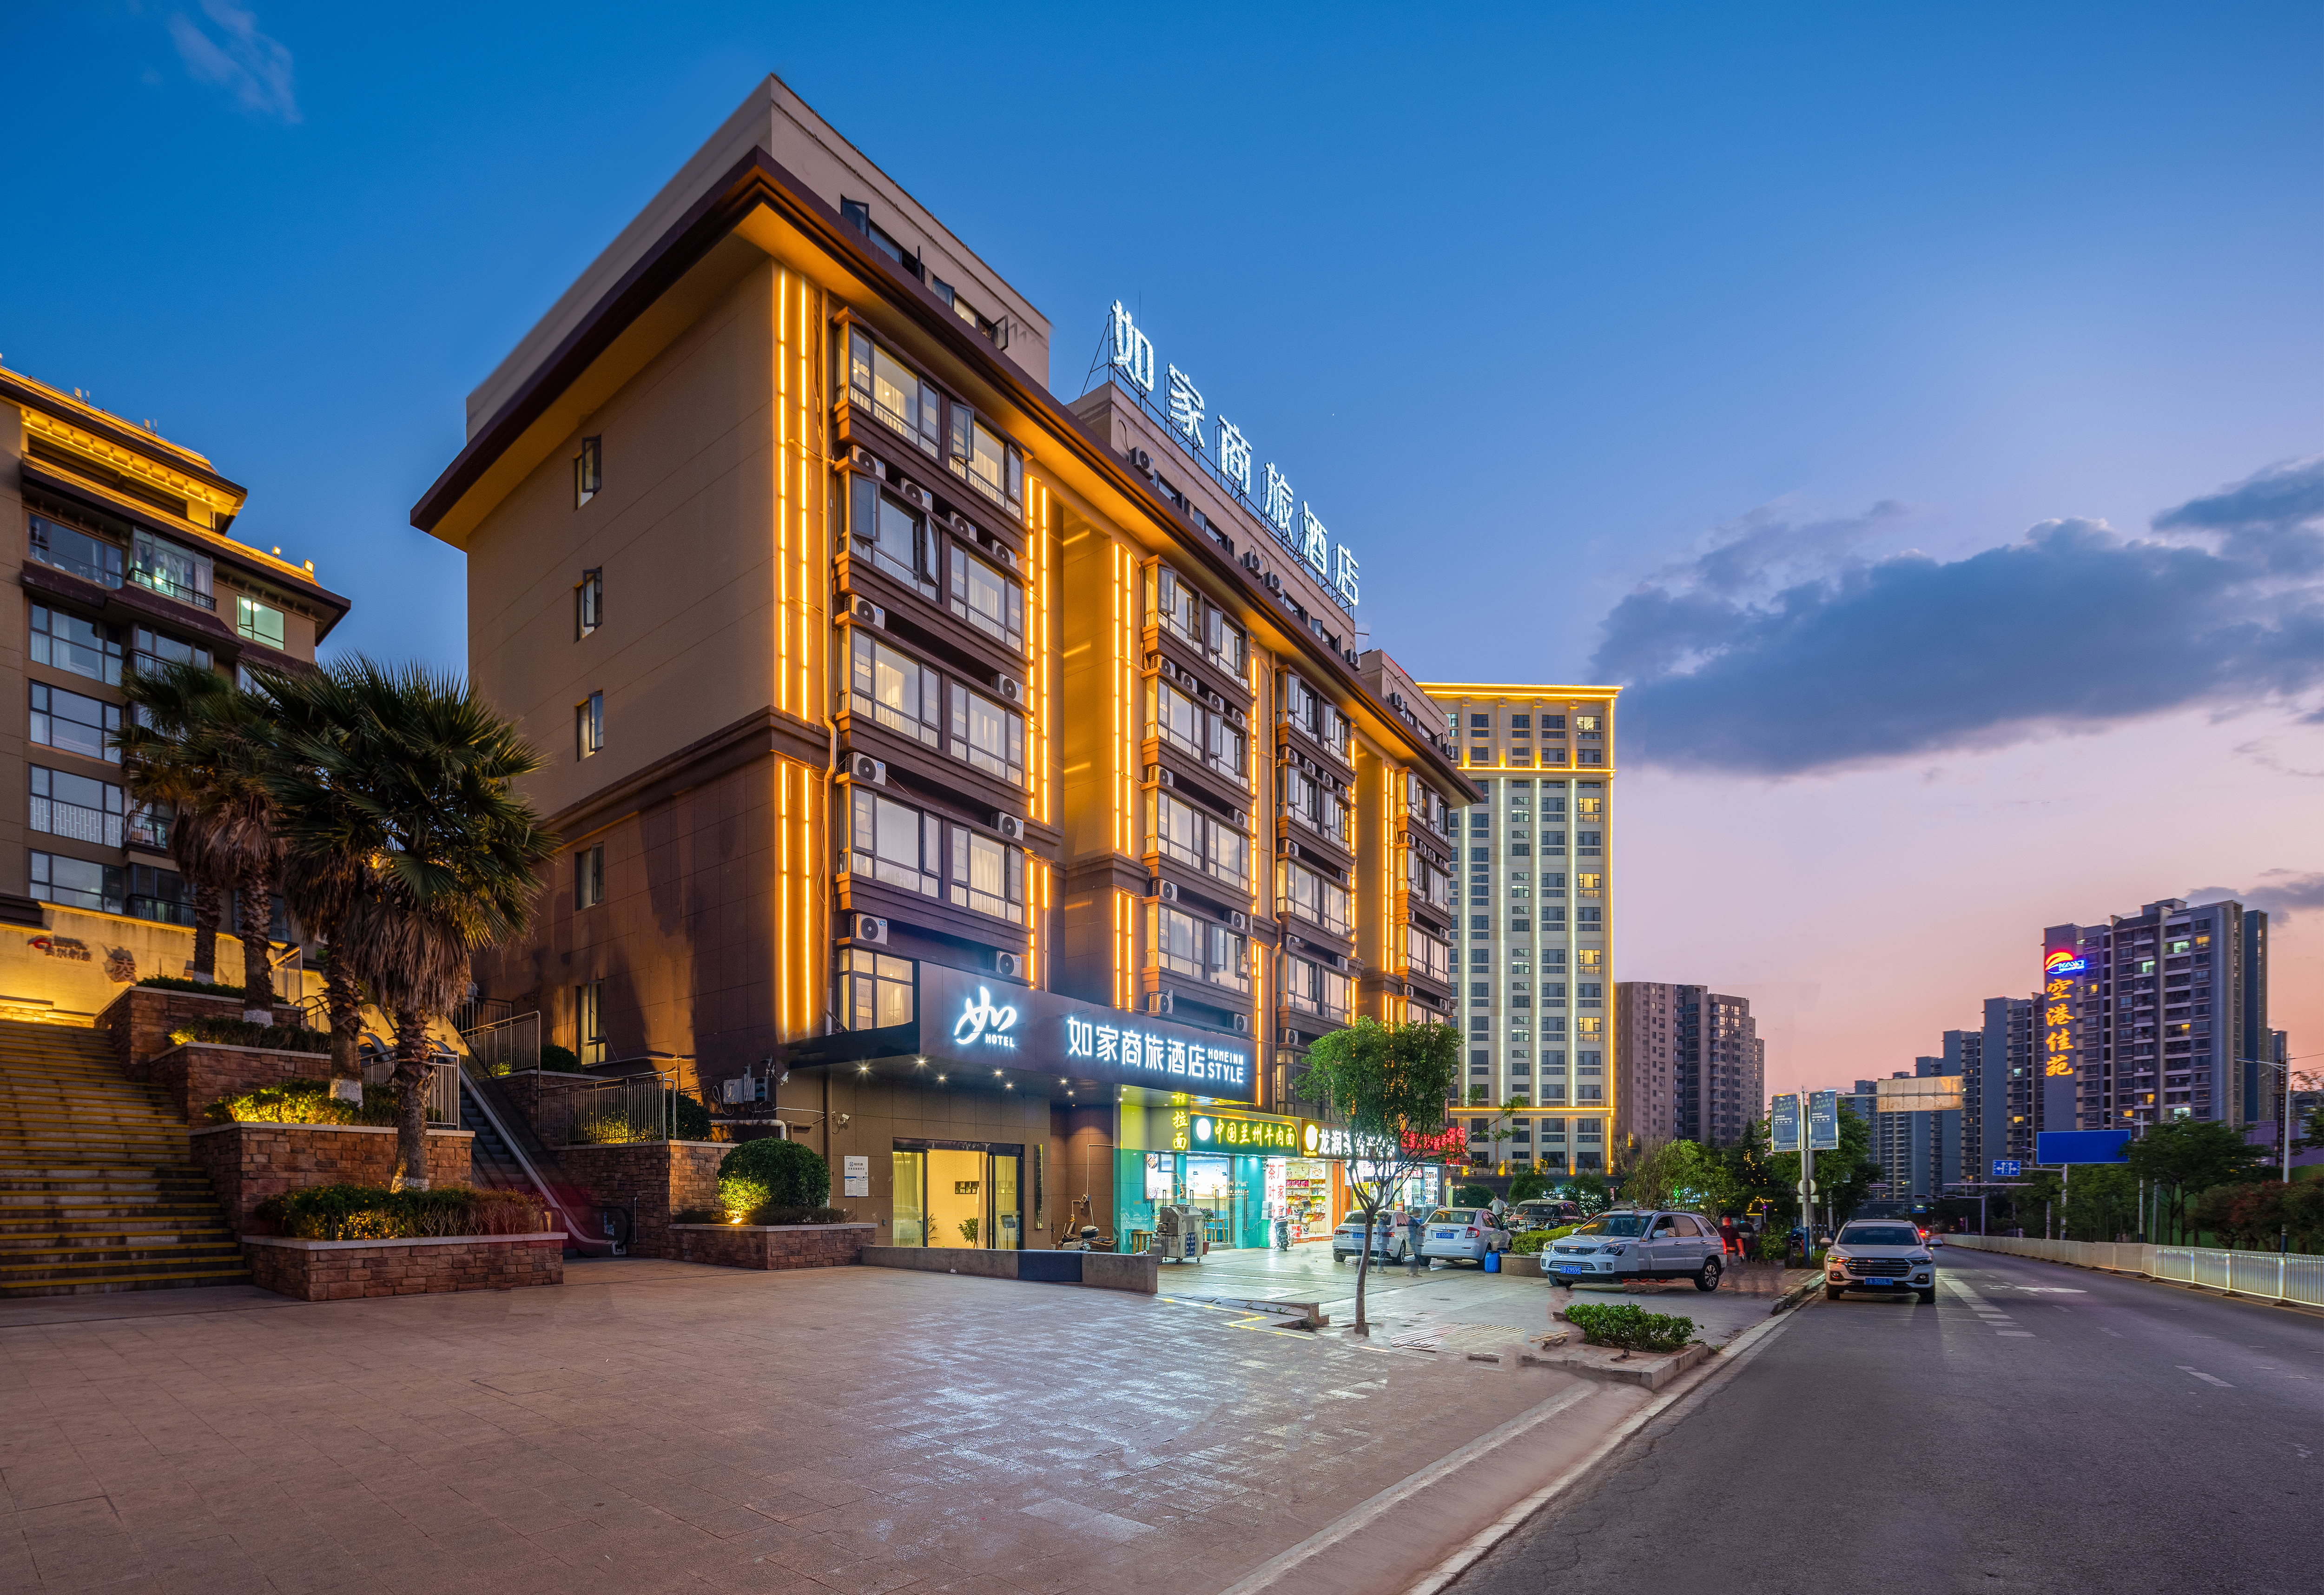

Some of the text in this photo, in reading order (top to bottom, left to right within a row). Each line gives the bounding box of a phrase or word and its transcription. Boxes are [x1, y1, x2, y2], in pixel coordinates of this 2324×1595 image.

[1110, 299, 1359, 605] 如家商旅酒店
[985, 1033, 1015, 1047] HOTEL
[1067, 1017, 1205, 1078] 如家商旅酒店
[2046, 979, 2074, 1077] 空港佳苑
[1208, 1062, 1243, 1083] STYLE
[1172, 1111, 1188, 1150] 拉面
[1214, 1118, 1295, 1148] 中国兰州牛肉面
